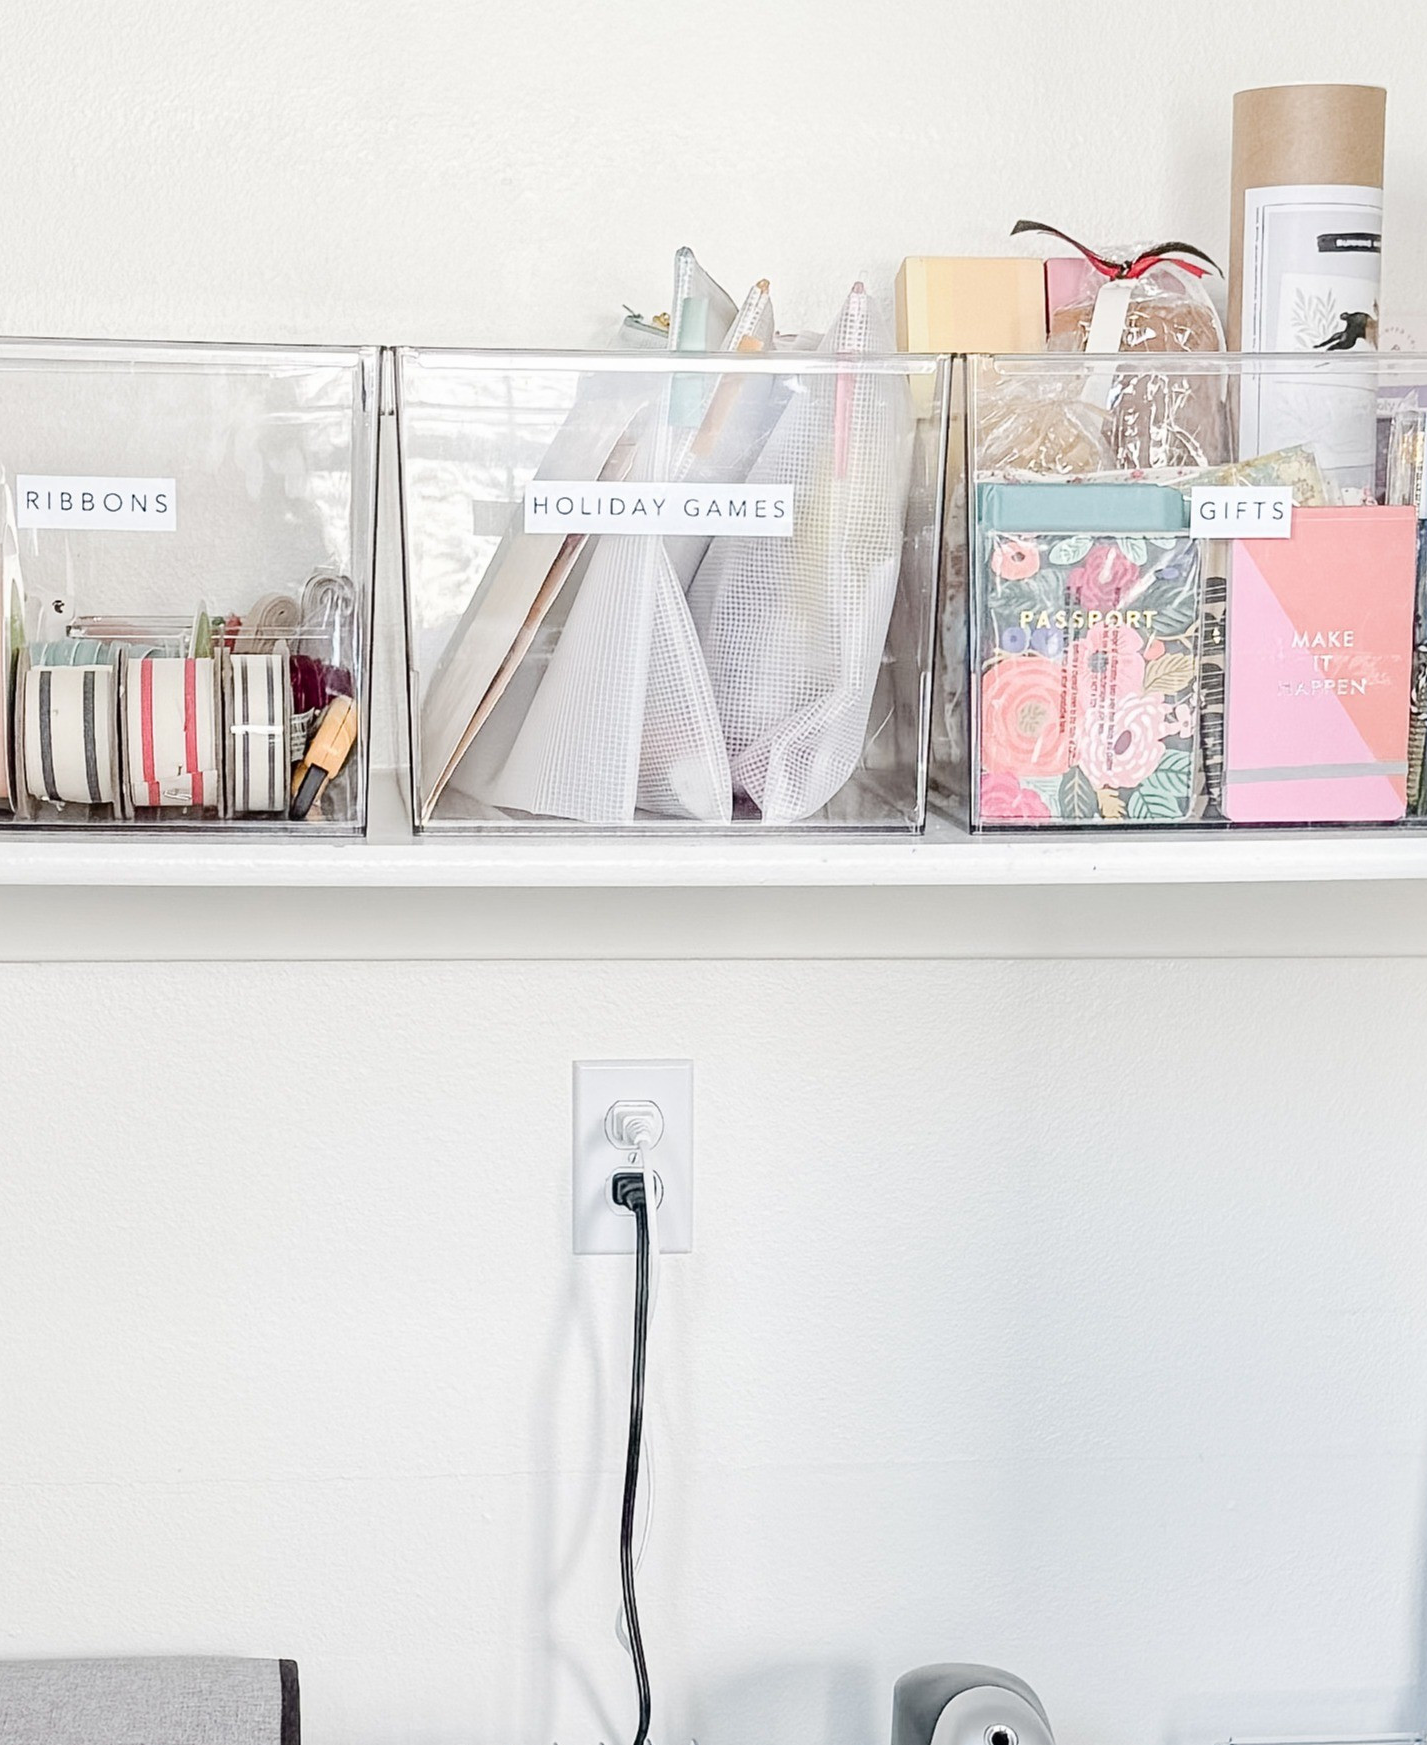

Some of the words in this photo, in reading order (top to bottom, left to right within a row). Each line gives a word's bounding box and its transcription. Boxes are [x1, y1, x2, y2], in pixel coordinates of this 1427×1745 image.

[26, 490, 168, 514] RIBBONS
[533, 496, 666, 517] HOLIDAY
[683, 498, 785, 519] GAMES
[1199, 500, 1284, 521] GIFTS
[1019, 608, 1158, 630] PASSPORT
[1291, 629, 1355, 649] MAKE
[1313, 653, 1333, 672] IT
[1277, 677, 1367, 697] HAPPEN
